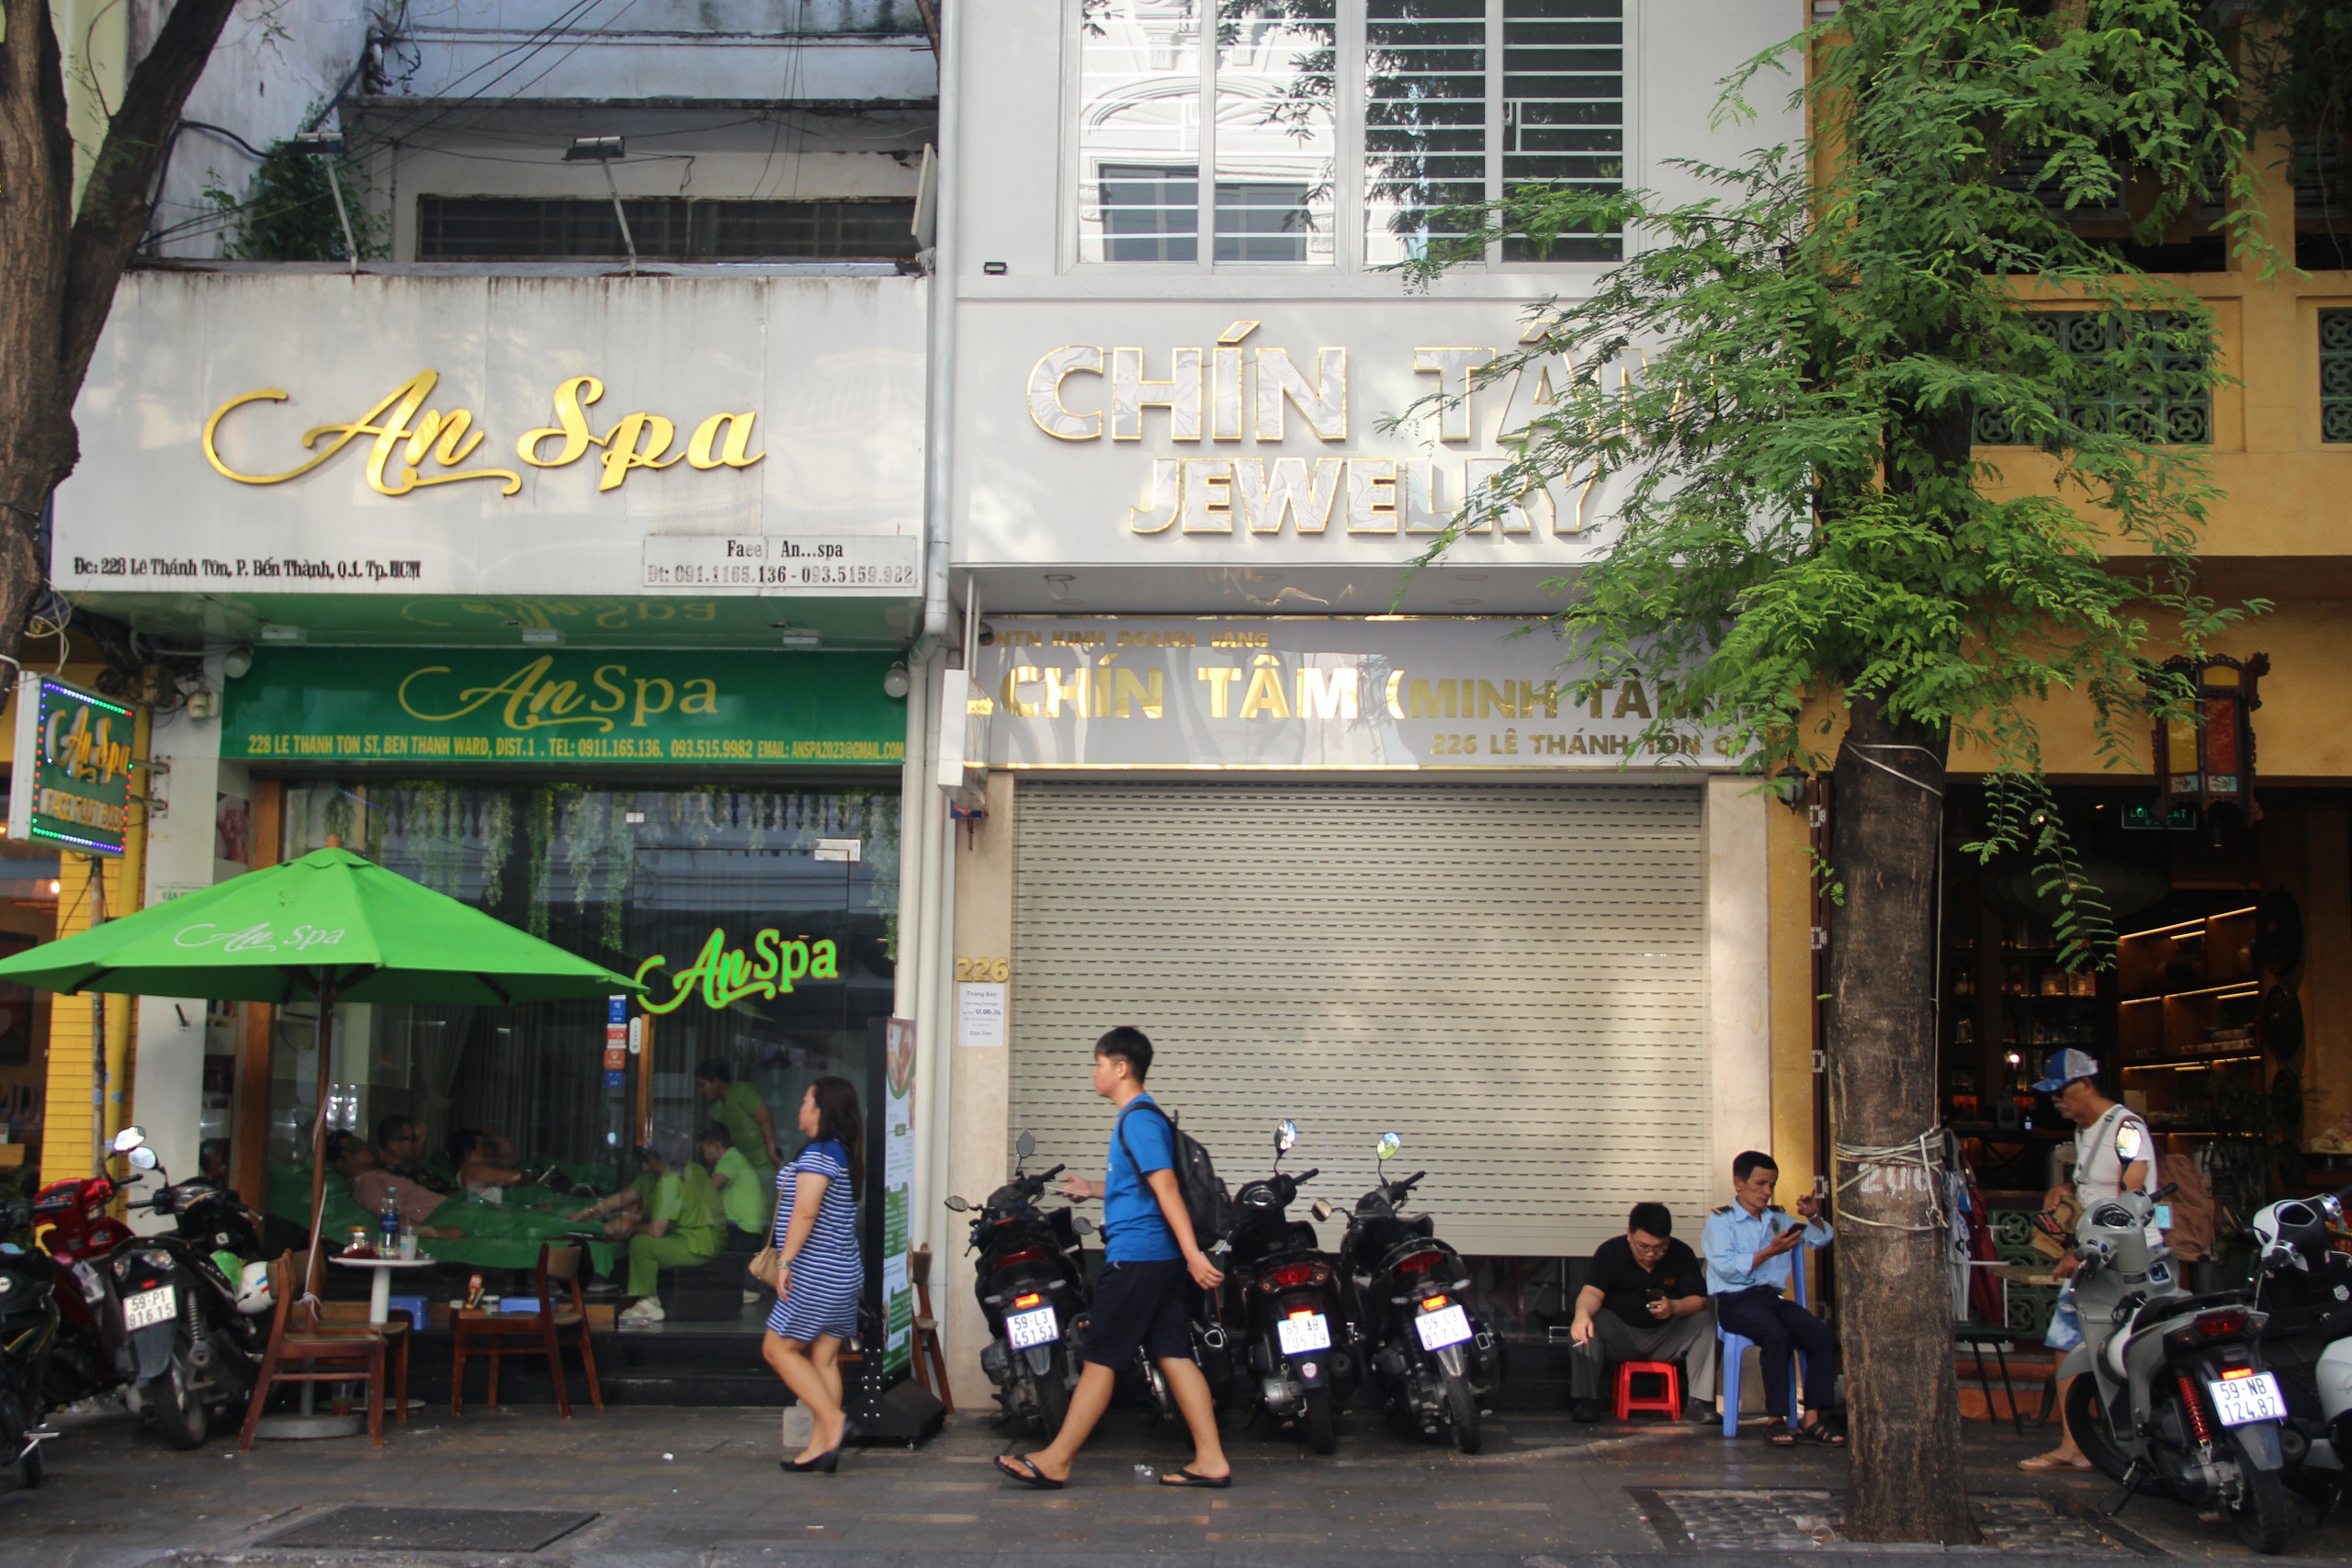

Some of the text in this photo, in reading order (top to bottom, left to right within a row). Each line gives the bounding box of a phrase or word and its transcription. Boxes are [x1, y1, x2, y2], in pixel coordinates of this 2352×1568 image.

[1025, 320, 1348, 443] CHÍN
[202, 368, 766, 495] An Spa
[1130, 457, 1601, 536] JEWELRY
[727, 540, 763, 558] Face
[100, 557, 127, 576] 228
[130, 558, 148, 575] Lê
[150, 558, 198, 577] Thánh
[235, 558, 249, 577] P.
[253, 556, 280, 578] Bến
[1117, 630, 1196, 648] DOANH
[399, 654, 719, 733] An Spa
[1001, 653, 1164, 719] CHÍN
[1197, 653, 1359, 719] TÂM
[247, 735, 272, 754] 228
[274, 736, 290, 754] LE
[293, 736, 334, 754] THANH
[336, 736, 361, 754] TON
[383, 736, 409, 754] BEN
[411, 736, 451, 755] THANH
[548, 738, 576, 757] TEL:
[757, 739, 790, 759] EMAIL:
[1430, 734, 1478, 755] 226
[1489, 728, 1519, 755] LÊ
[1528, 727, 1629, 755] THÁNH
[174, 921, 345, 953] An Spa
[752, 928, 839, 993] Spa
[956, 957, 1010, 983] 226
[131, 1290, 165, 1311] 59-P1
[2220, 1377, 2267, 1401] 59-NB
[2224, 1396, 2276, 1422] 124.87
